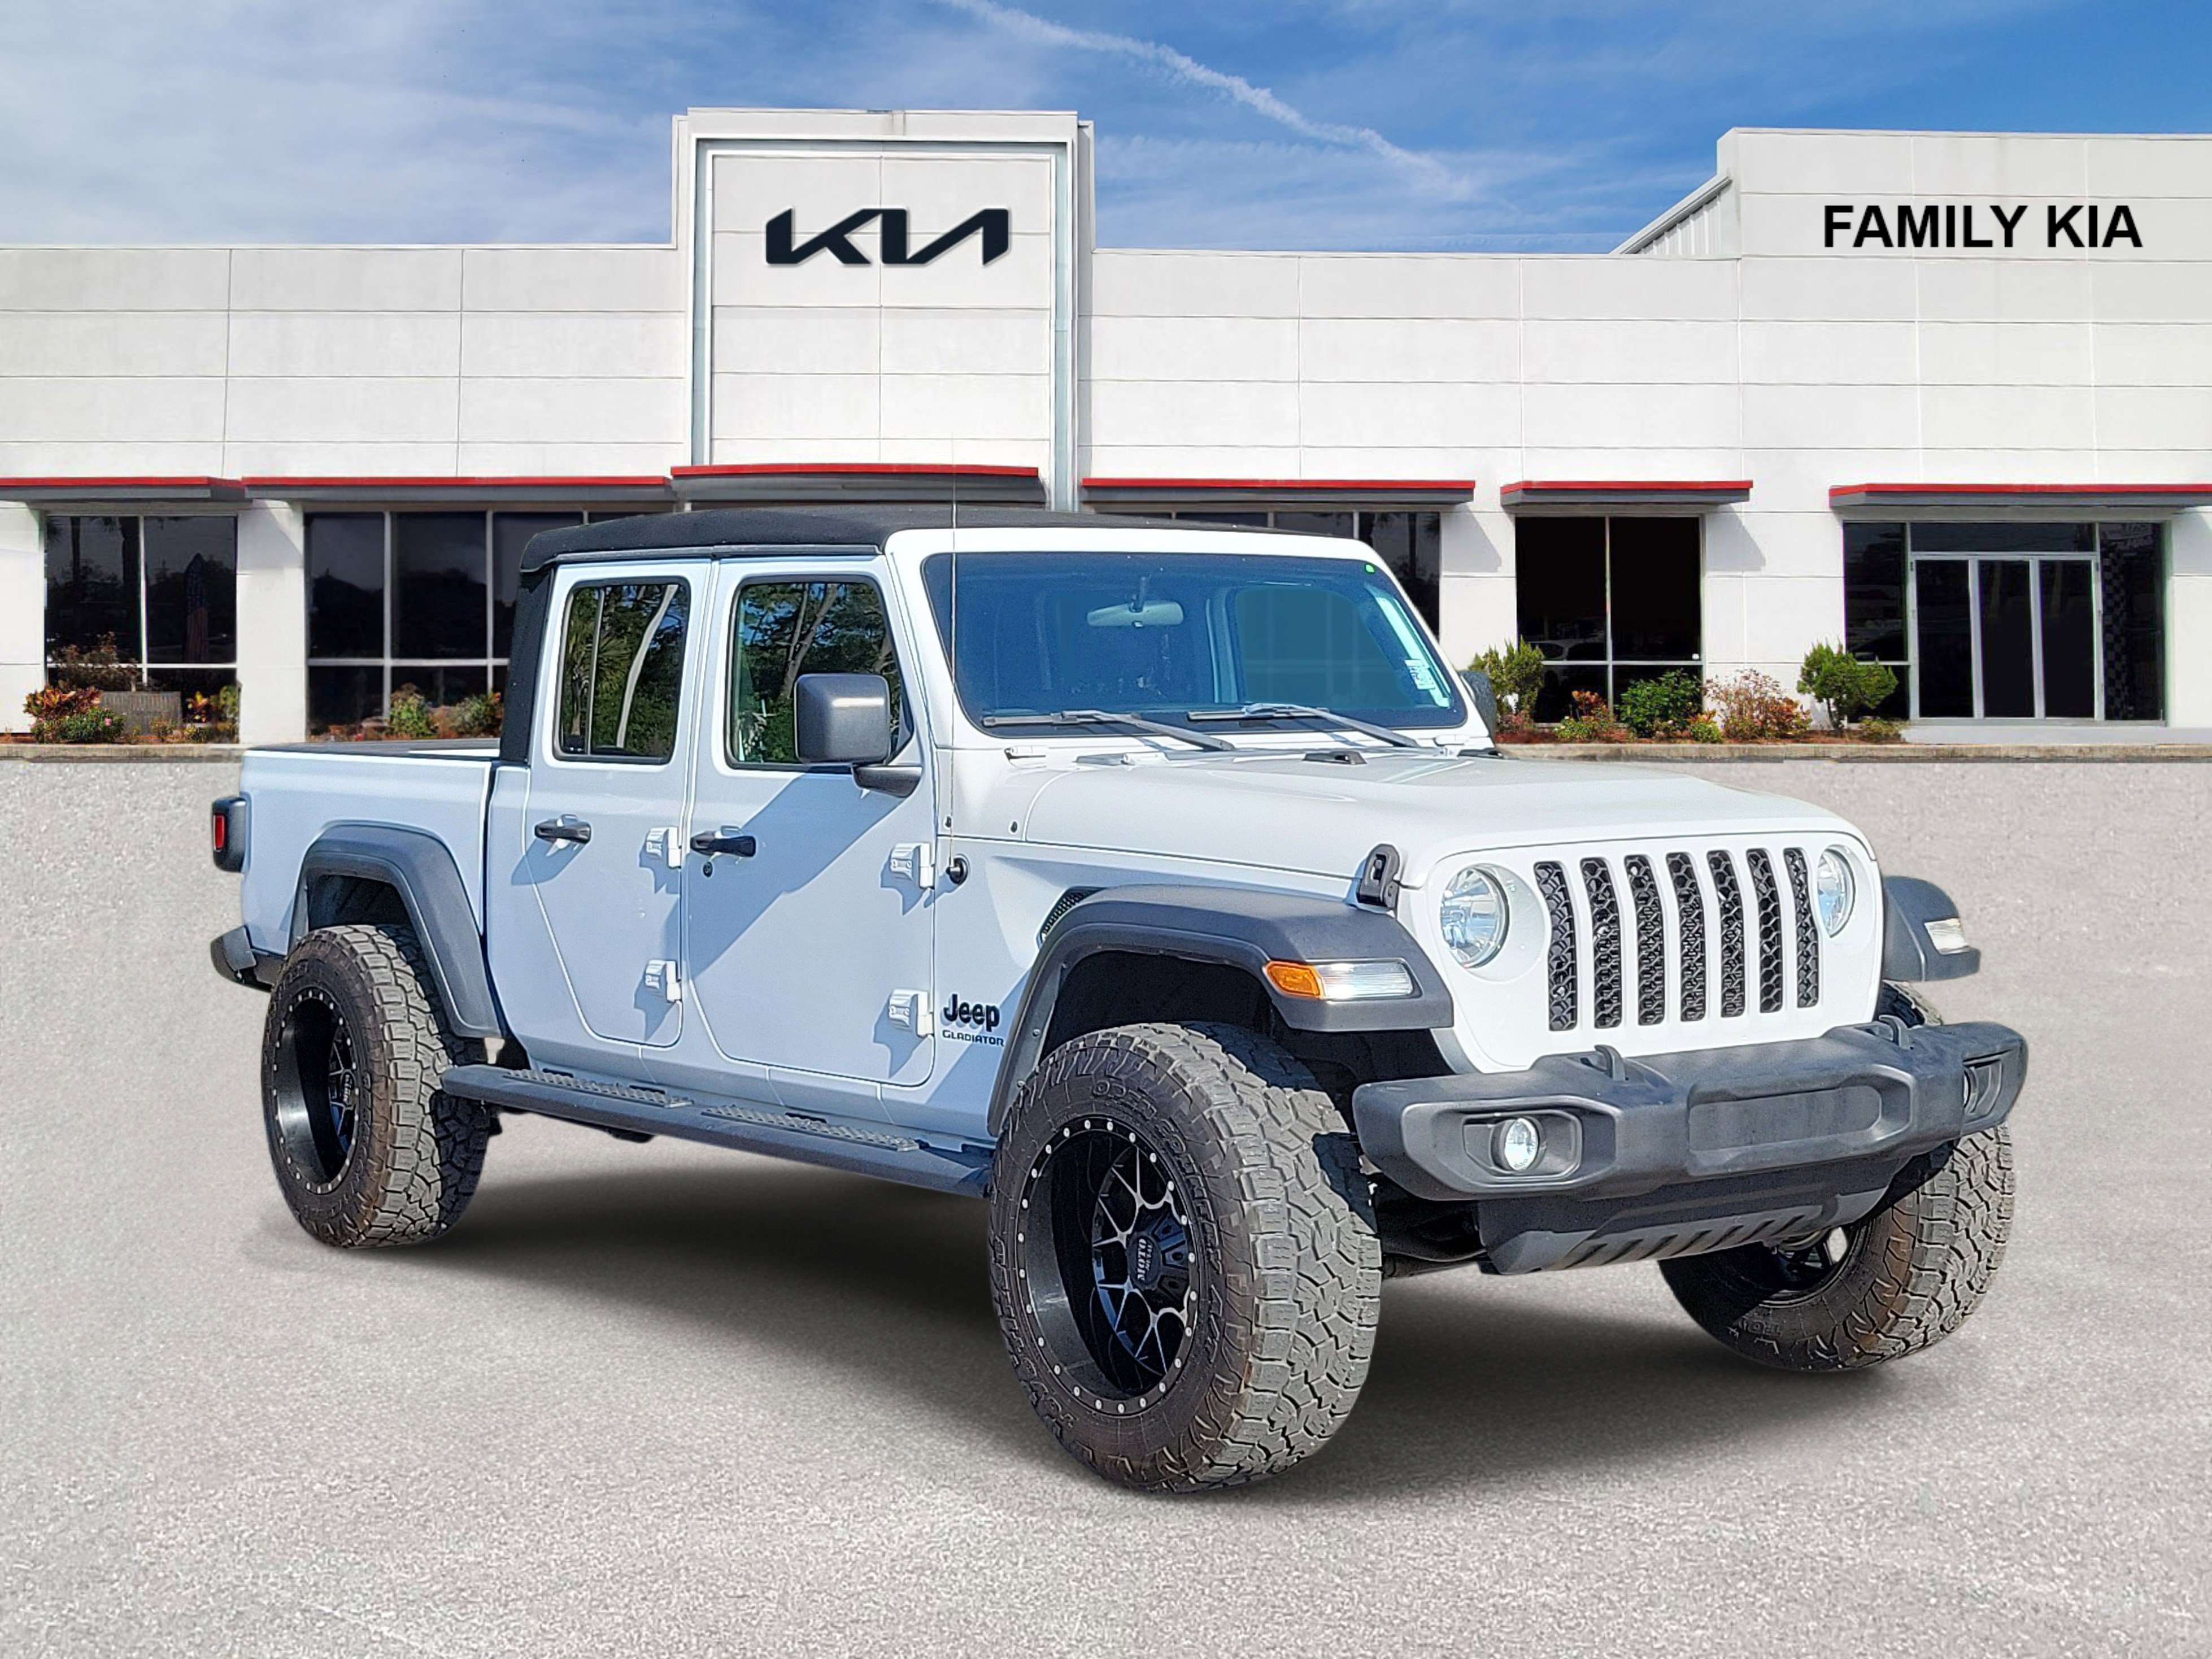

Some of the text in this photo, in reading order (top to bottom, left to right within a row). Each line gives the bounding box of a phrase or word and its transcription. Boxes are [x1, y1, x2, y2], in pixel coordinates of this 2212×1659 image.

[766, 208, 1009, 265] KIA
[1825, 205, 2143, 247] FAMILY KIA
[943, 994, 1000, 1032] Jeep
[942, 1030, 1004, 1047] GLADIATOR
[1093, 1079, 1156, 1120] OPEN
[1156, 1118, 1223, 1275] COUNTRY
[1137, 1238, 1147, 1281] MOTO
